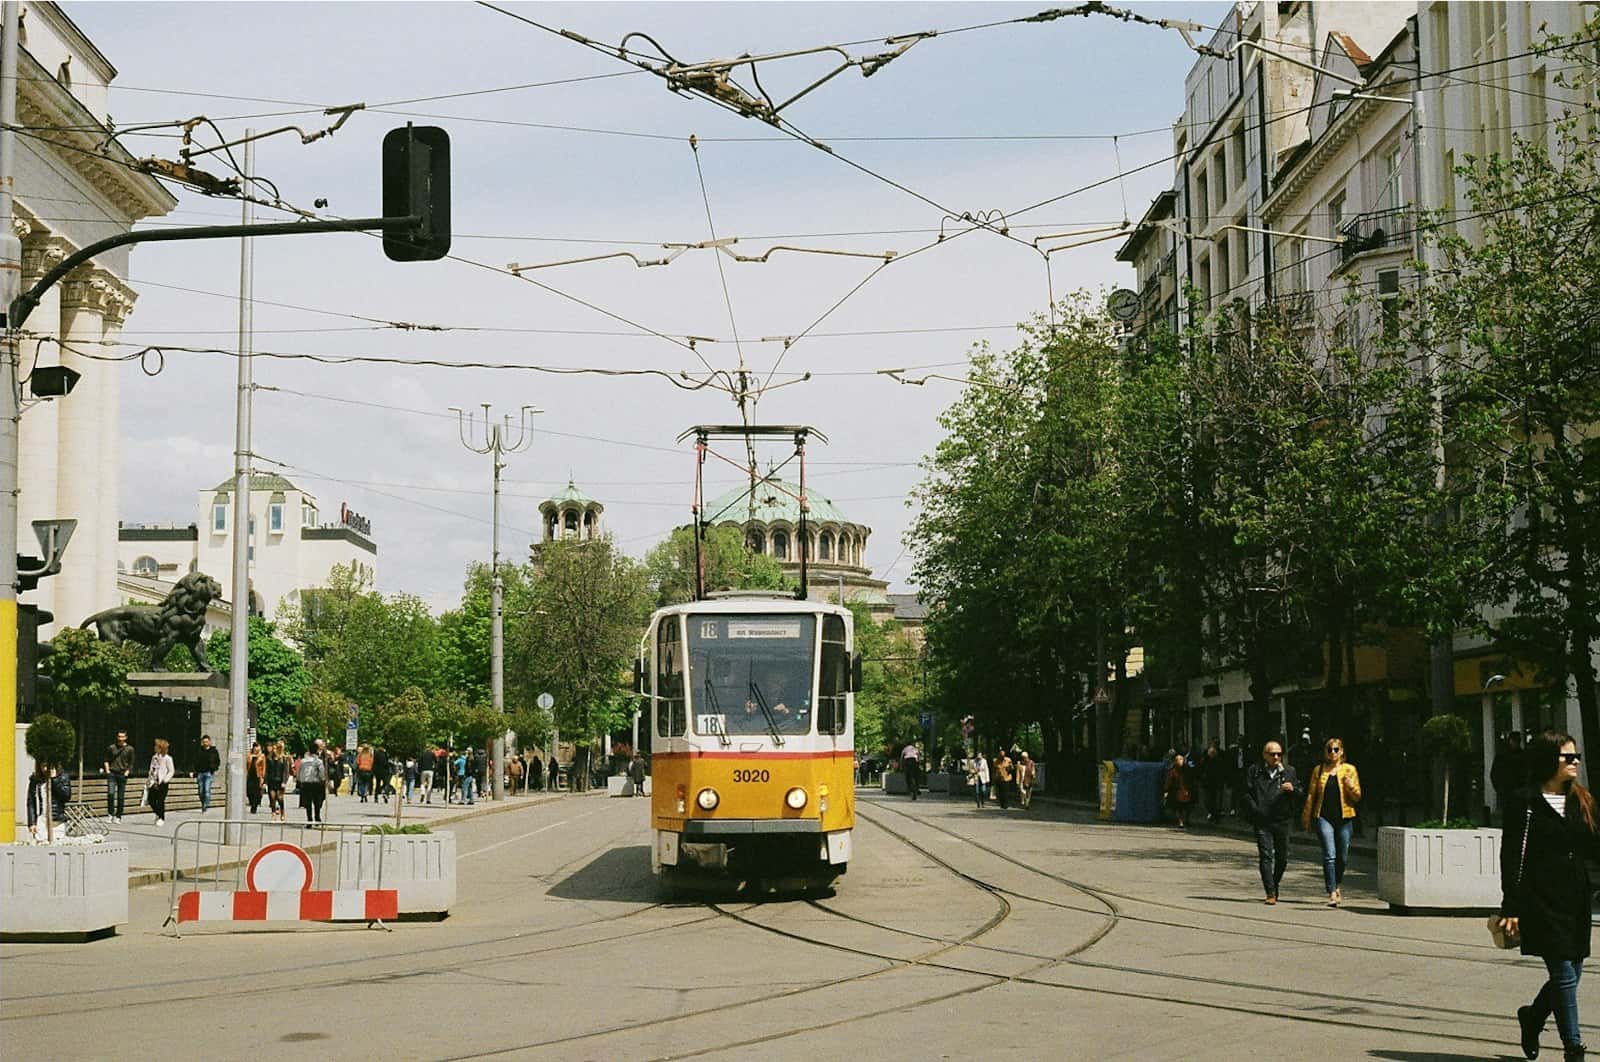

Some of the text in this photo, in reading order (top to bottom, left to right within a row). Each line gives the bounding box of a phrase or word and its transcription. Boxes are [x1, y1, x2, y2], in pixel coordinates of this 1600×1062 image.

[702, 623, 717, 637] 18
[704, 717, 718, 733] 18
[733, 769, 770, 783] 3020
